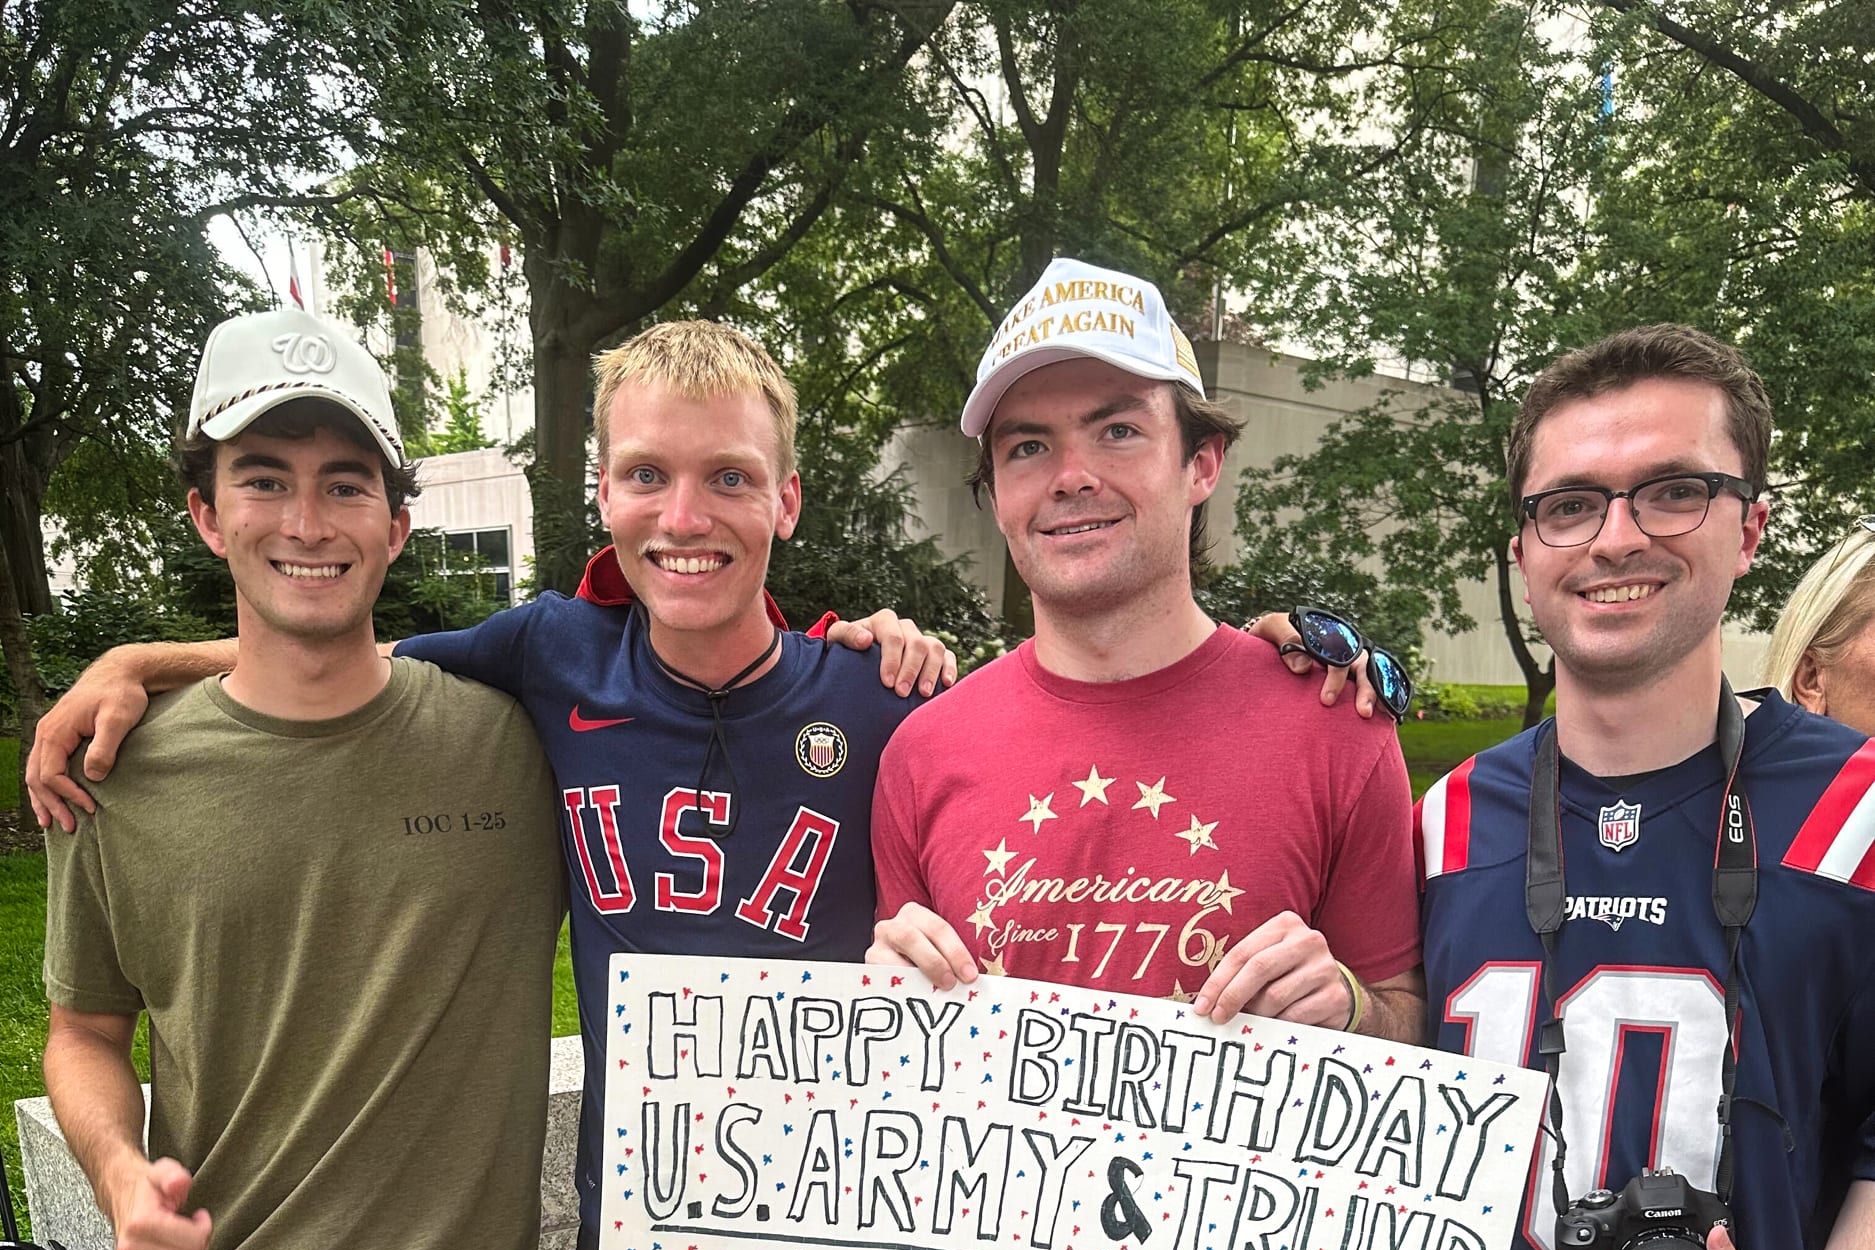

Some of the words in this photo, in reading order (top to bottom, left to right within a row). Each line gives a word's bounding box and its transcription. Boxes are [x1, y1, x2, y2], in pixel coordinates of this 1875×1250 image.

[1040, 279, 1146, 316] AMERICA
[1058, 310, 1136, 340] AGAIN
[402, 814, 452, 836] IOC
[461, 811, 506, 832] 1-25
[1604, 821, 1633, 843] NFL
[1728, 794, 1744, 843] EOS
[562, 784, 842, 944] USA
[977, 857, 1226, 912] American
[1564, 896, 1668, 926] PATRIOTS
[987, 919, 1059, 956] Since
[1061, 905, 1220, 980] 1776
[648, 991, 965, 1092] HAPPY
[1008, 1008, 1520, 1201] BIRTHDAY
[1100, 1156, 1153, 1244] &
[1644, 1208, 1682, 1218] Canon
